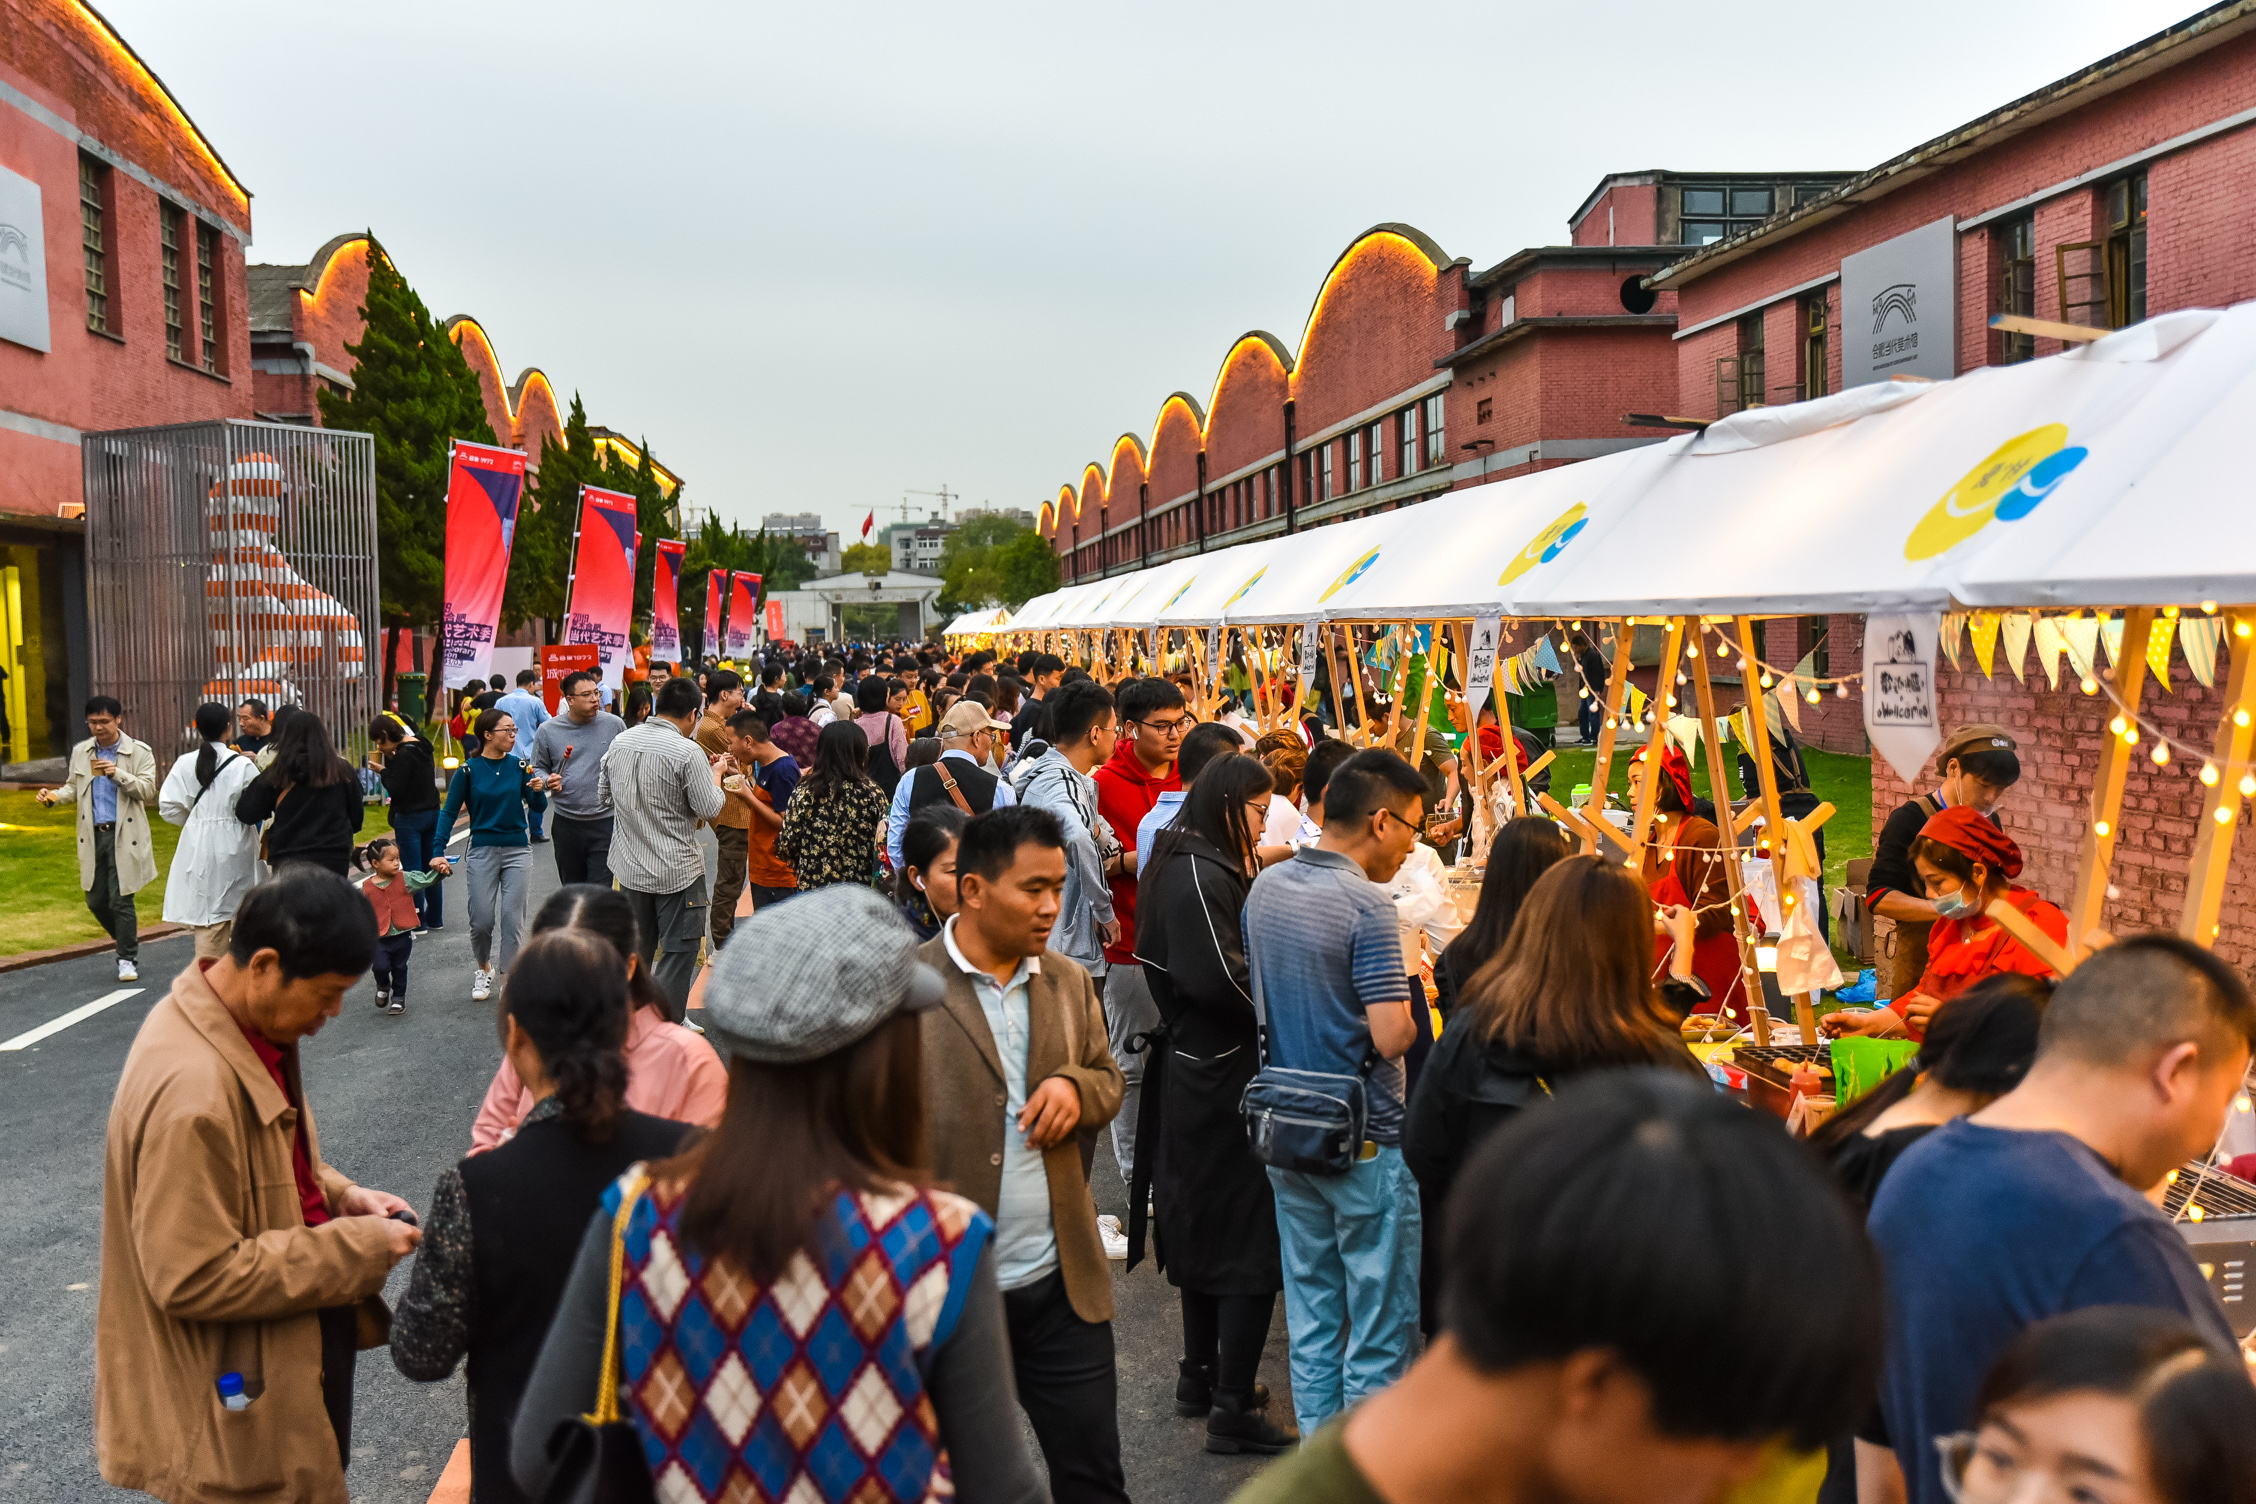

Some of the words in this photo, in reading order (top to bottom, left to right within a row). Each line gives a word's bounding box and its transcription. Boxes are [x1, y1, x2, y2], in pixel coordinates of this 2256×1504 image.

[570, 629, 625, 647] 当代艺术季
